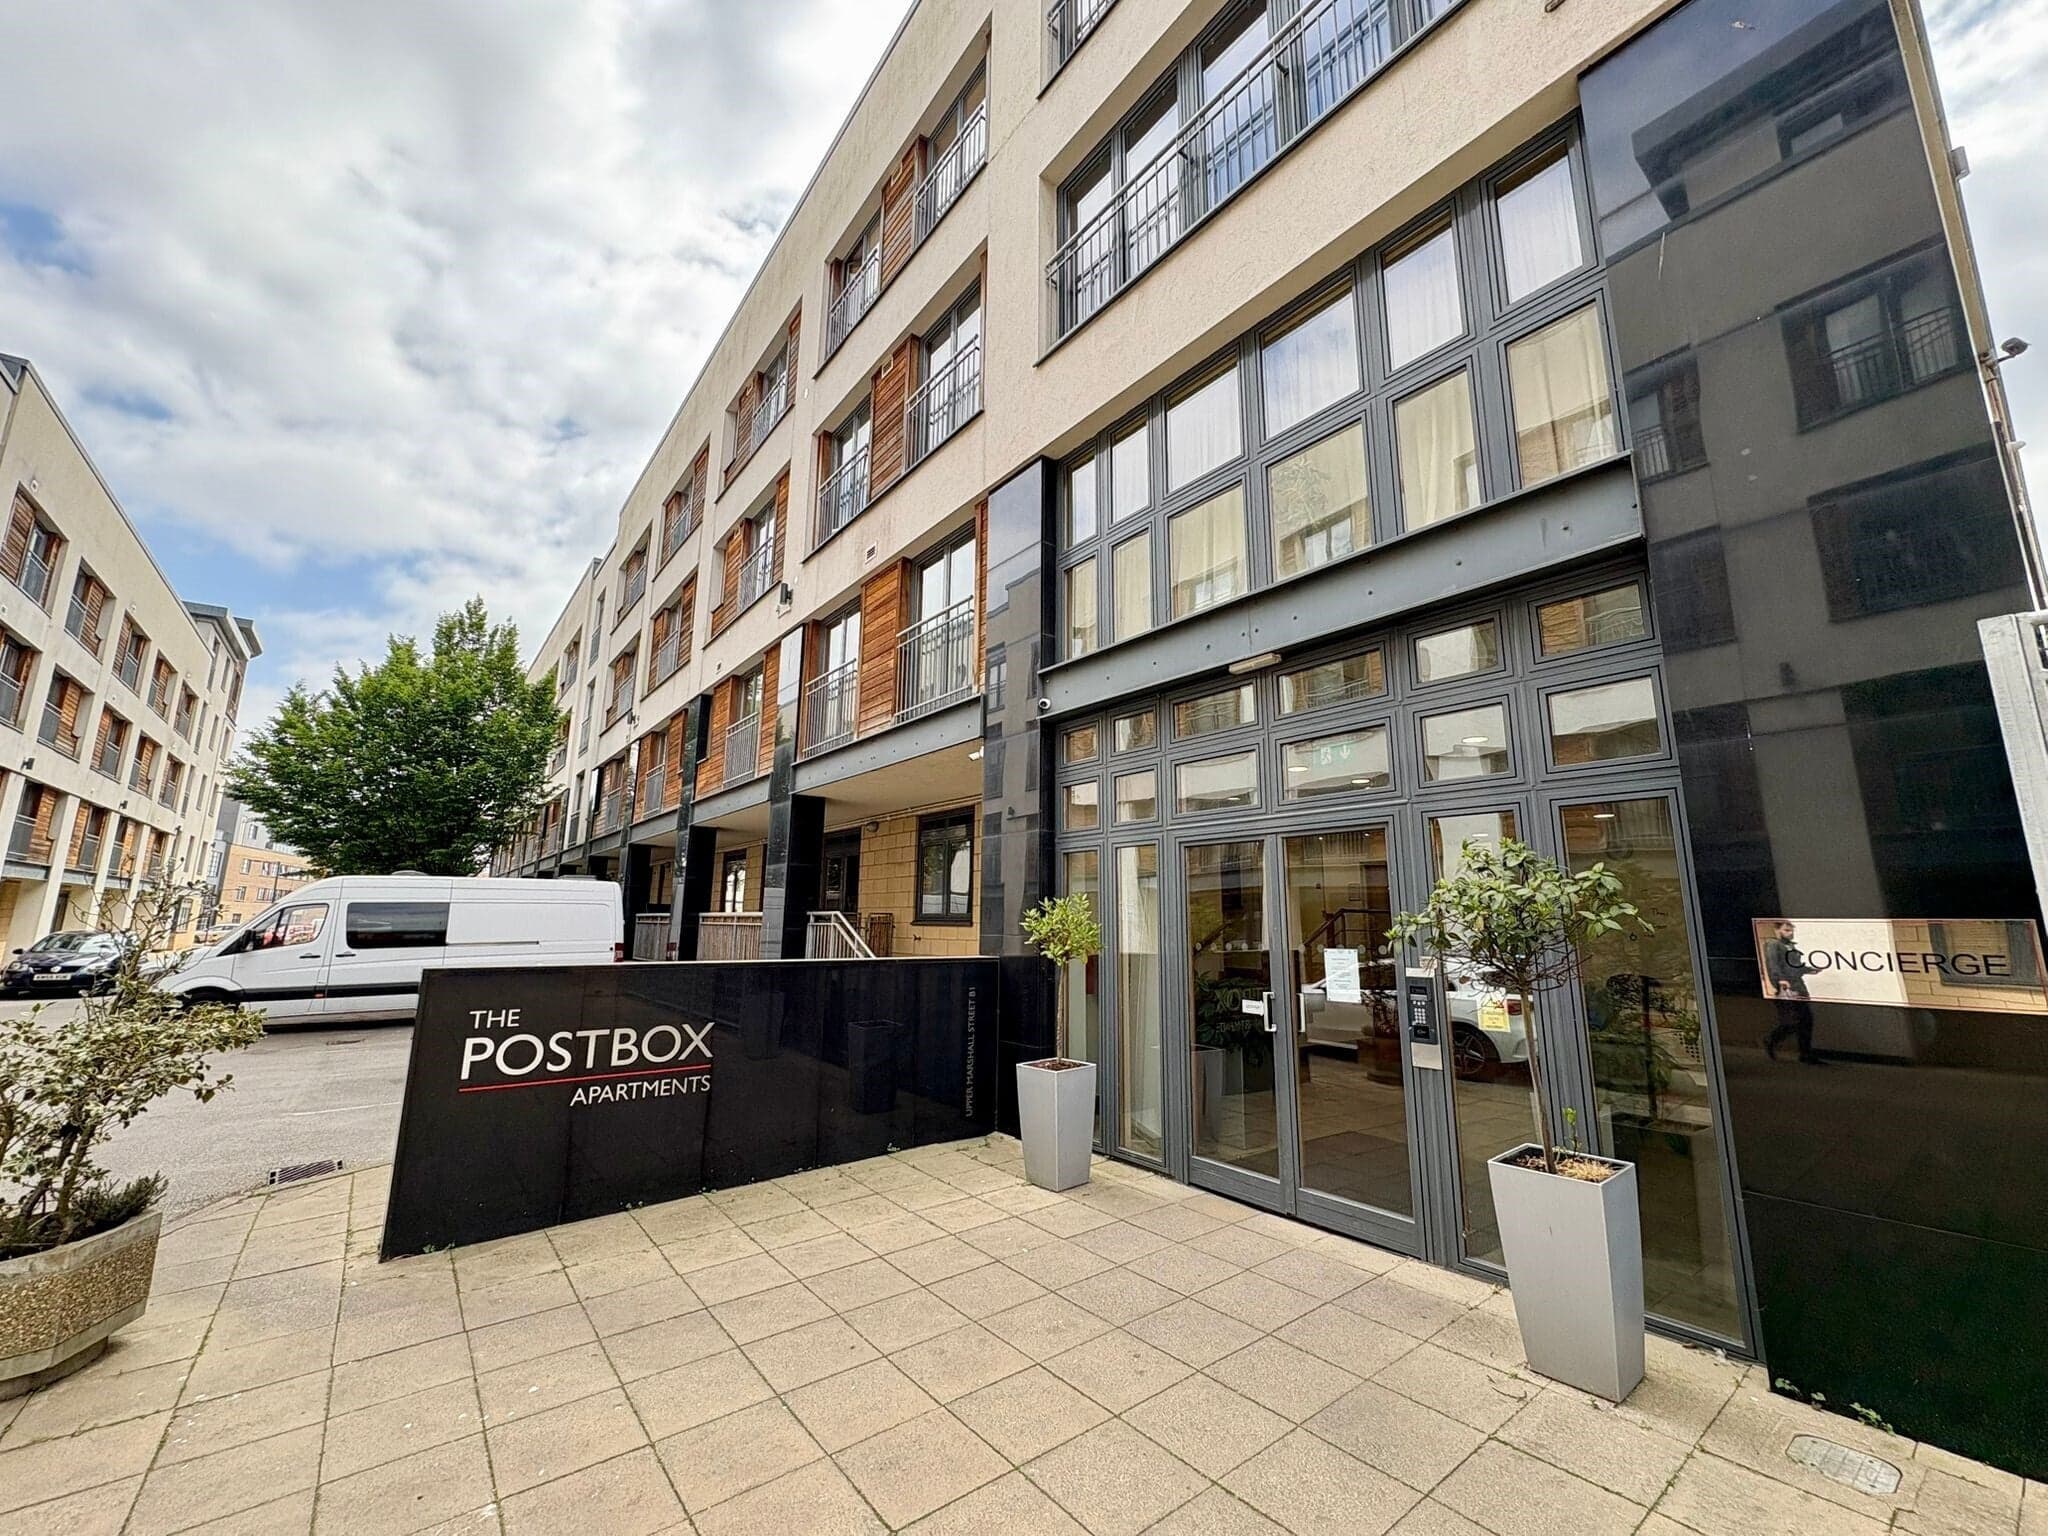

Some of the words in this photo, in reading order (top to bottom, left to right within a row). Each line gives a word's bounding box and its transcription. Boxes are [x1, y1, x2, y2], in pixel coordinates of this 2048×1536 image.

[1785, 950, 2011, 976] CONCIERGE
[469, 1008, 521, 1030] THE
[967, 998, 976, 1033] STREET
[460, 1022, 715, 1080] POSTBOX
[966, 1034, 975, 1084] MARSHALL
[569, 1075, 711, 1106] APARTMENTS
[965, 1086, 974, 1117] UPPER
